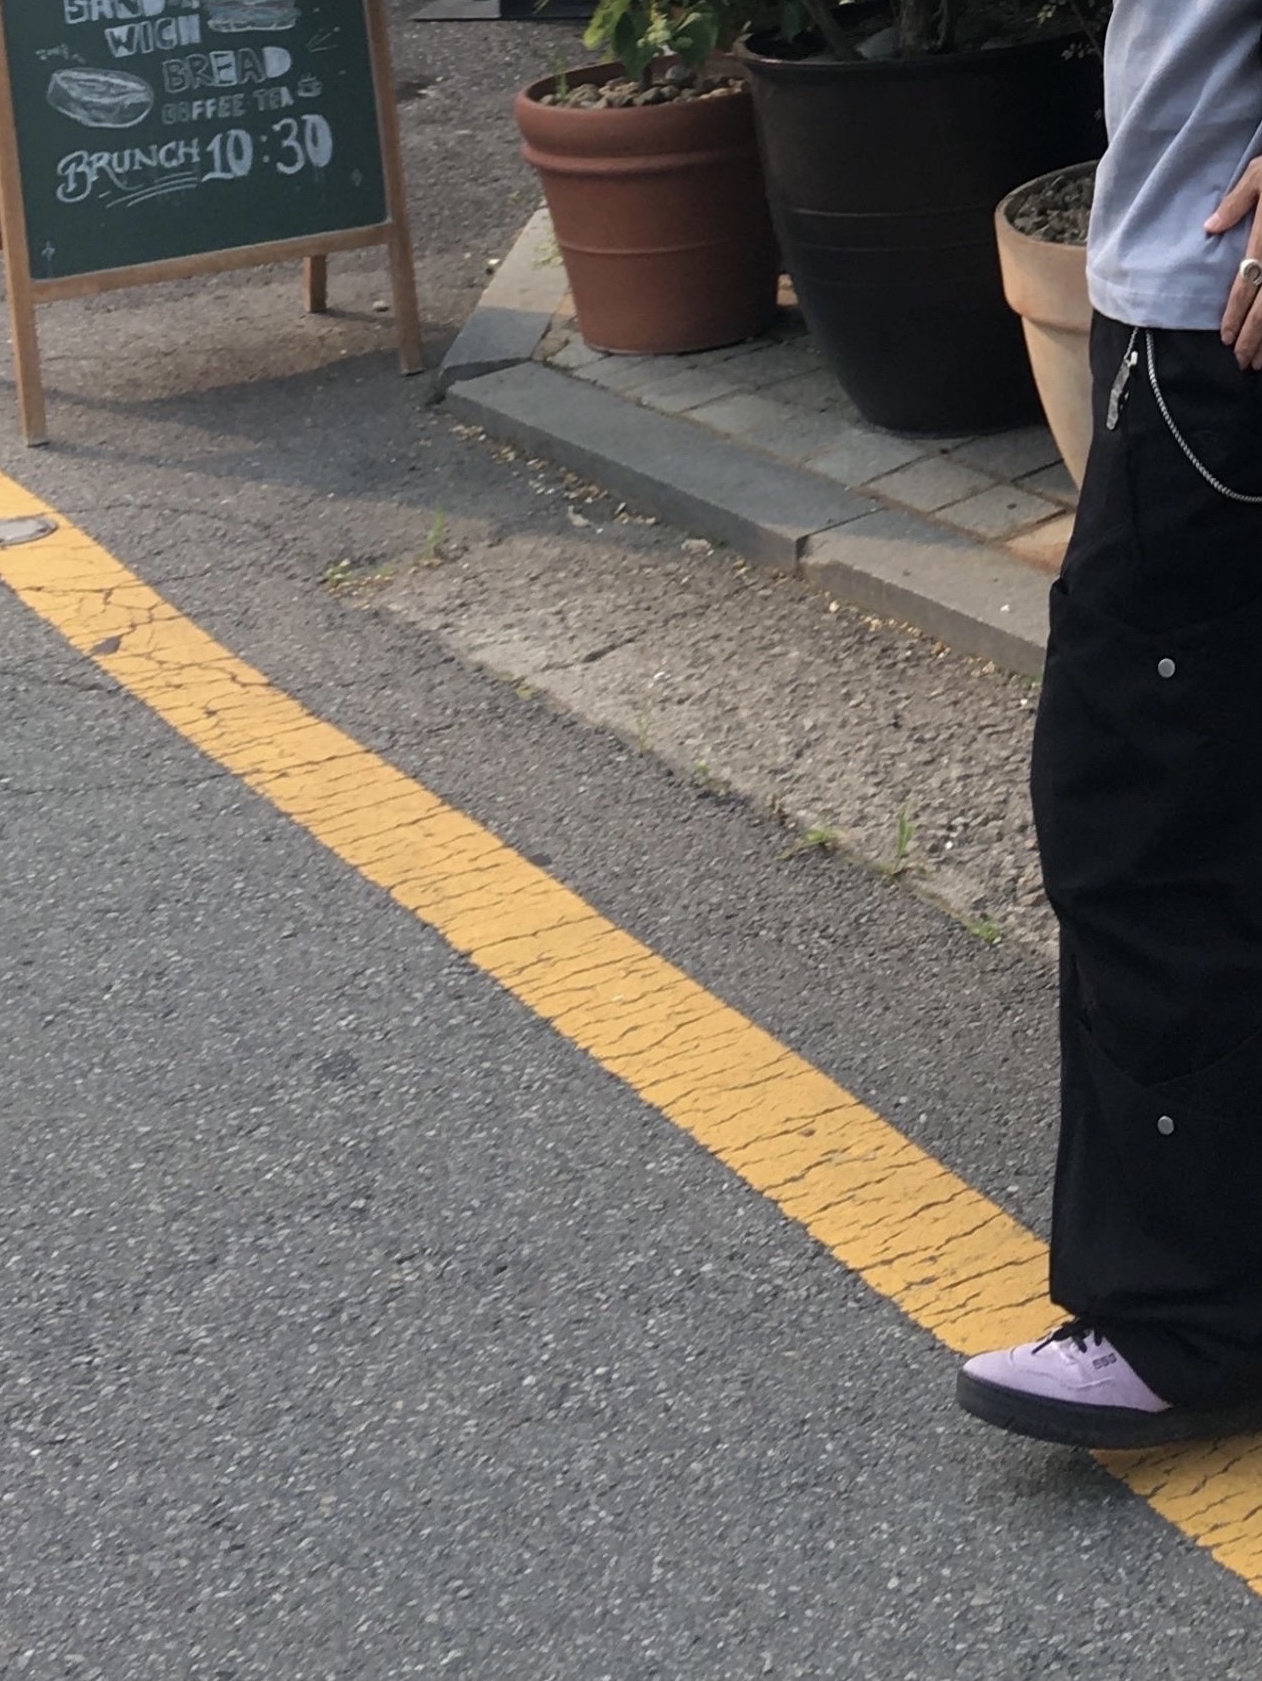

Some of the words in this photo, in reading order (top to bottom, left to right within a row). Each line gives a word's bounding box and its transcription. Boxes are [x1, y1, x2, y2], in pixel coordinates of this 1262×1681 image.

[104, 14, 201, 58] WICH
[162, 46, 292, 93] BREAD
[161, 93, 246, 125] COFFEE
[252, 86, 295, 112] TEA
[56, 137, 201, 203] BRUNCH
[201, 114, 333, 183] 10:30
